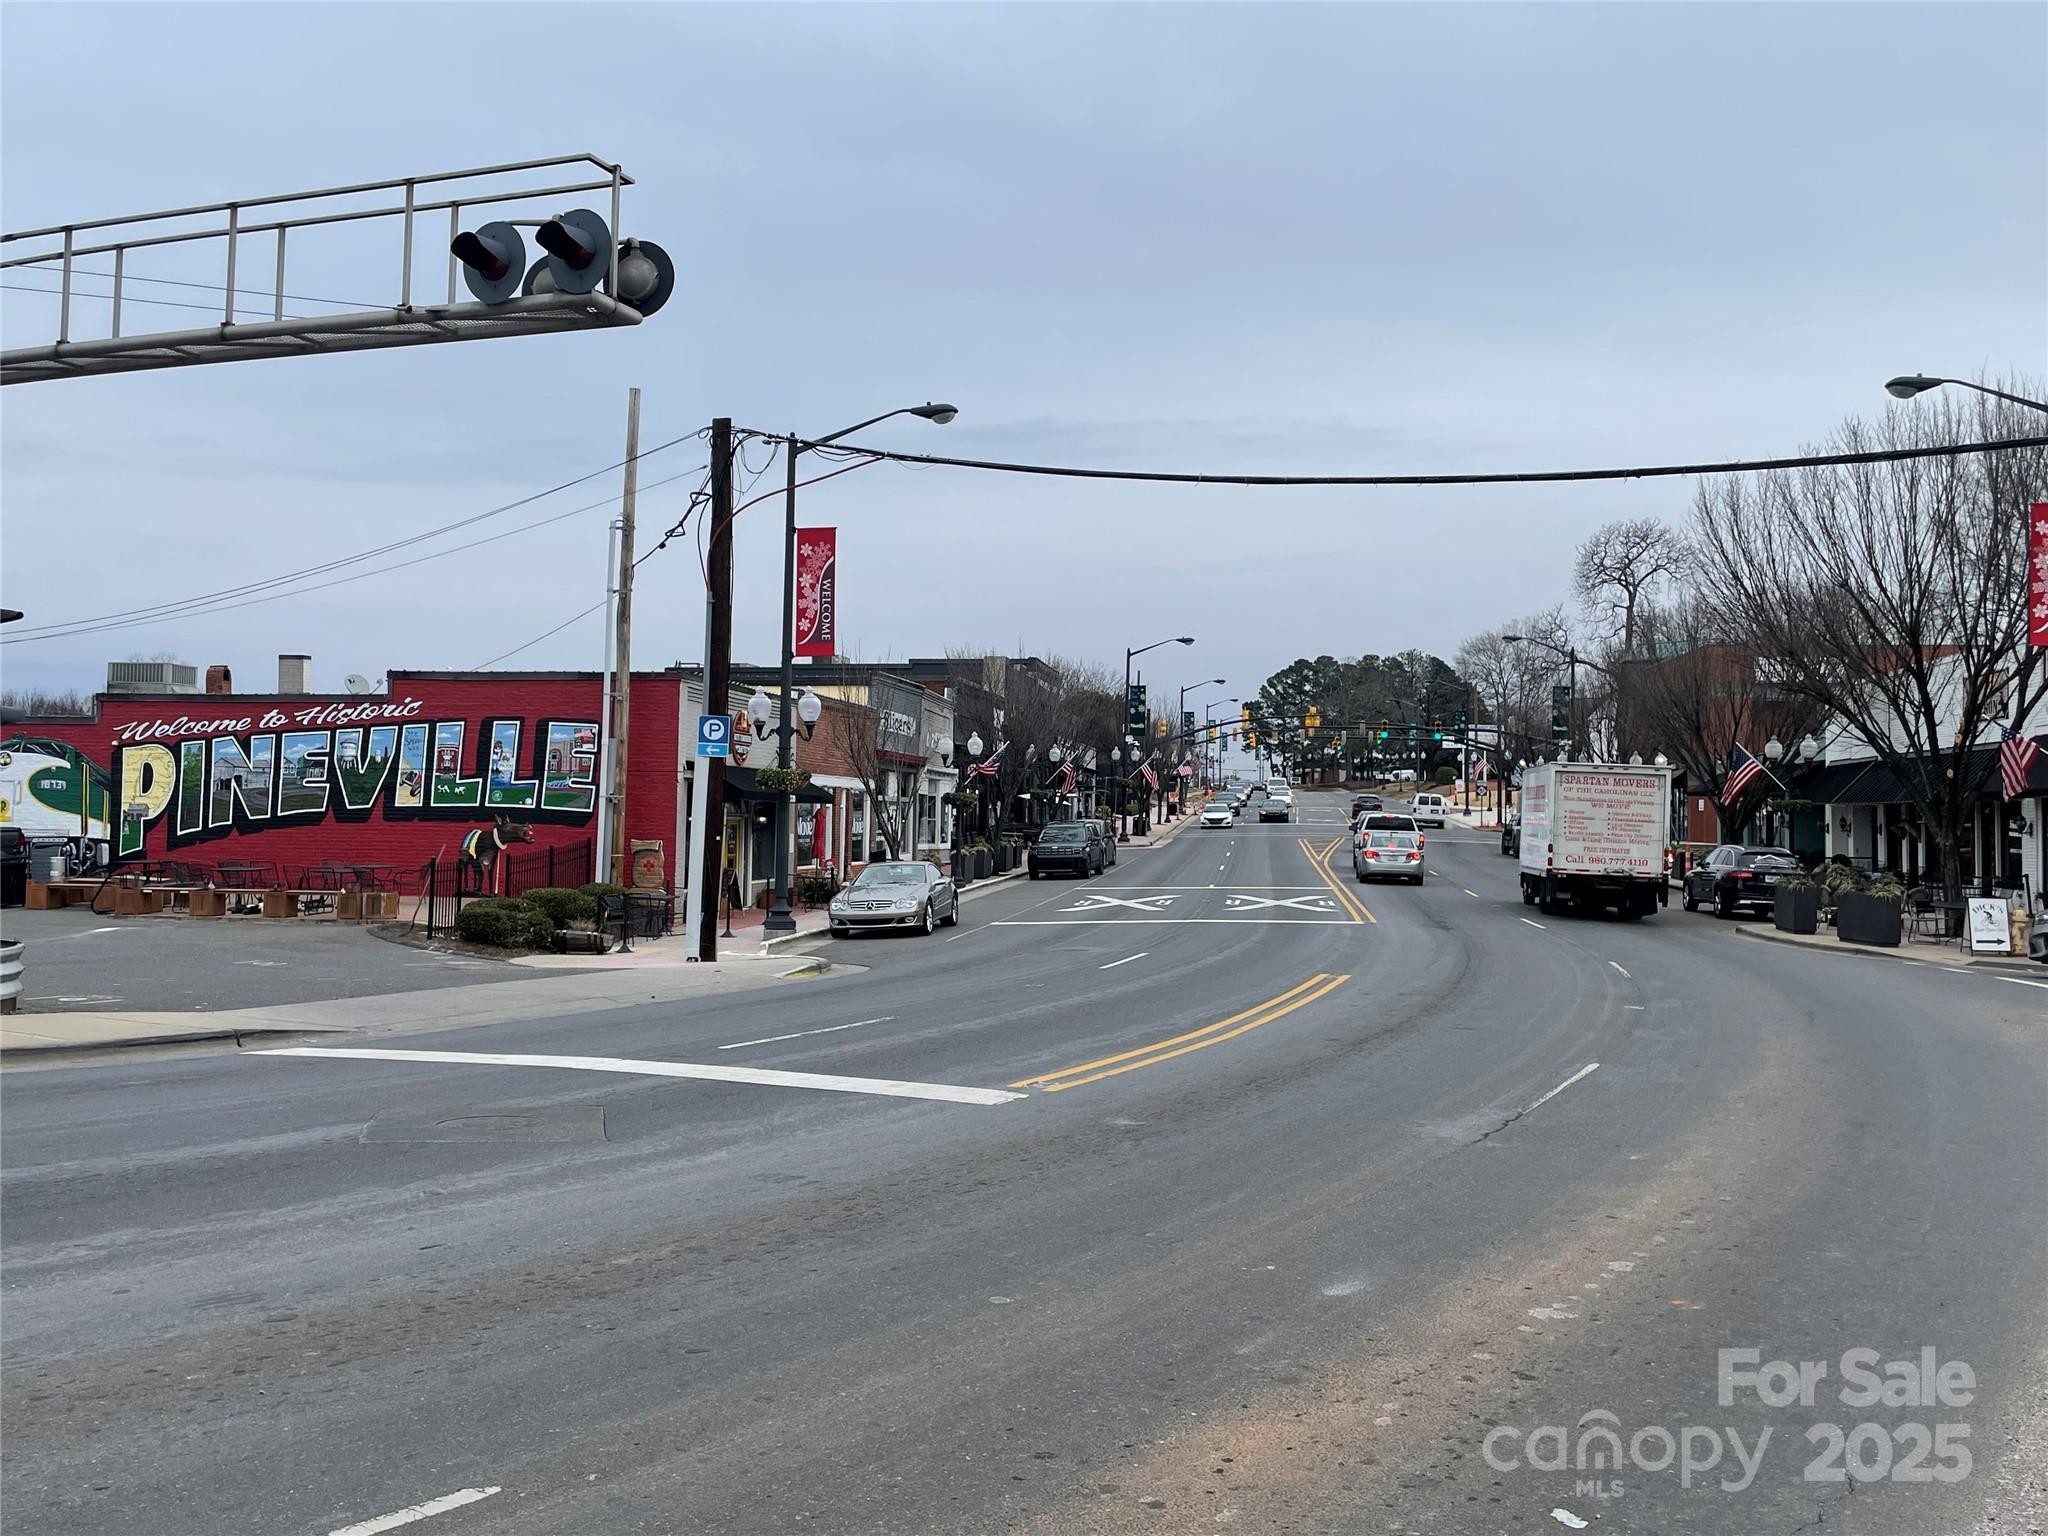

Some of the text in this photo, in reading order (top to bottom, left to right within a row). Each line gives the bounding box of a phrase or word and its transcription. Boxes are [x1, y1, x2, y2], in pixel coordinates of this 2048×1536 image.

[822, 579, 831, 641] WELCOME
[113, 697, 422, 741] Welcome to Historic
[709, 723, 721, 737] P
[119, 720, 598, 856] PINEVILLE
[1563, 775, 1656, 788] SPARTAN MOVERS
[1565, 855, 1648, 866] Call 980.777.4110
